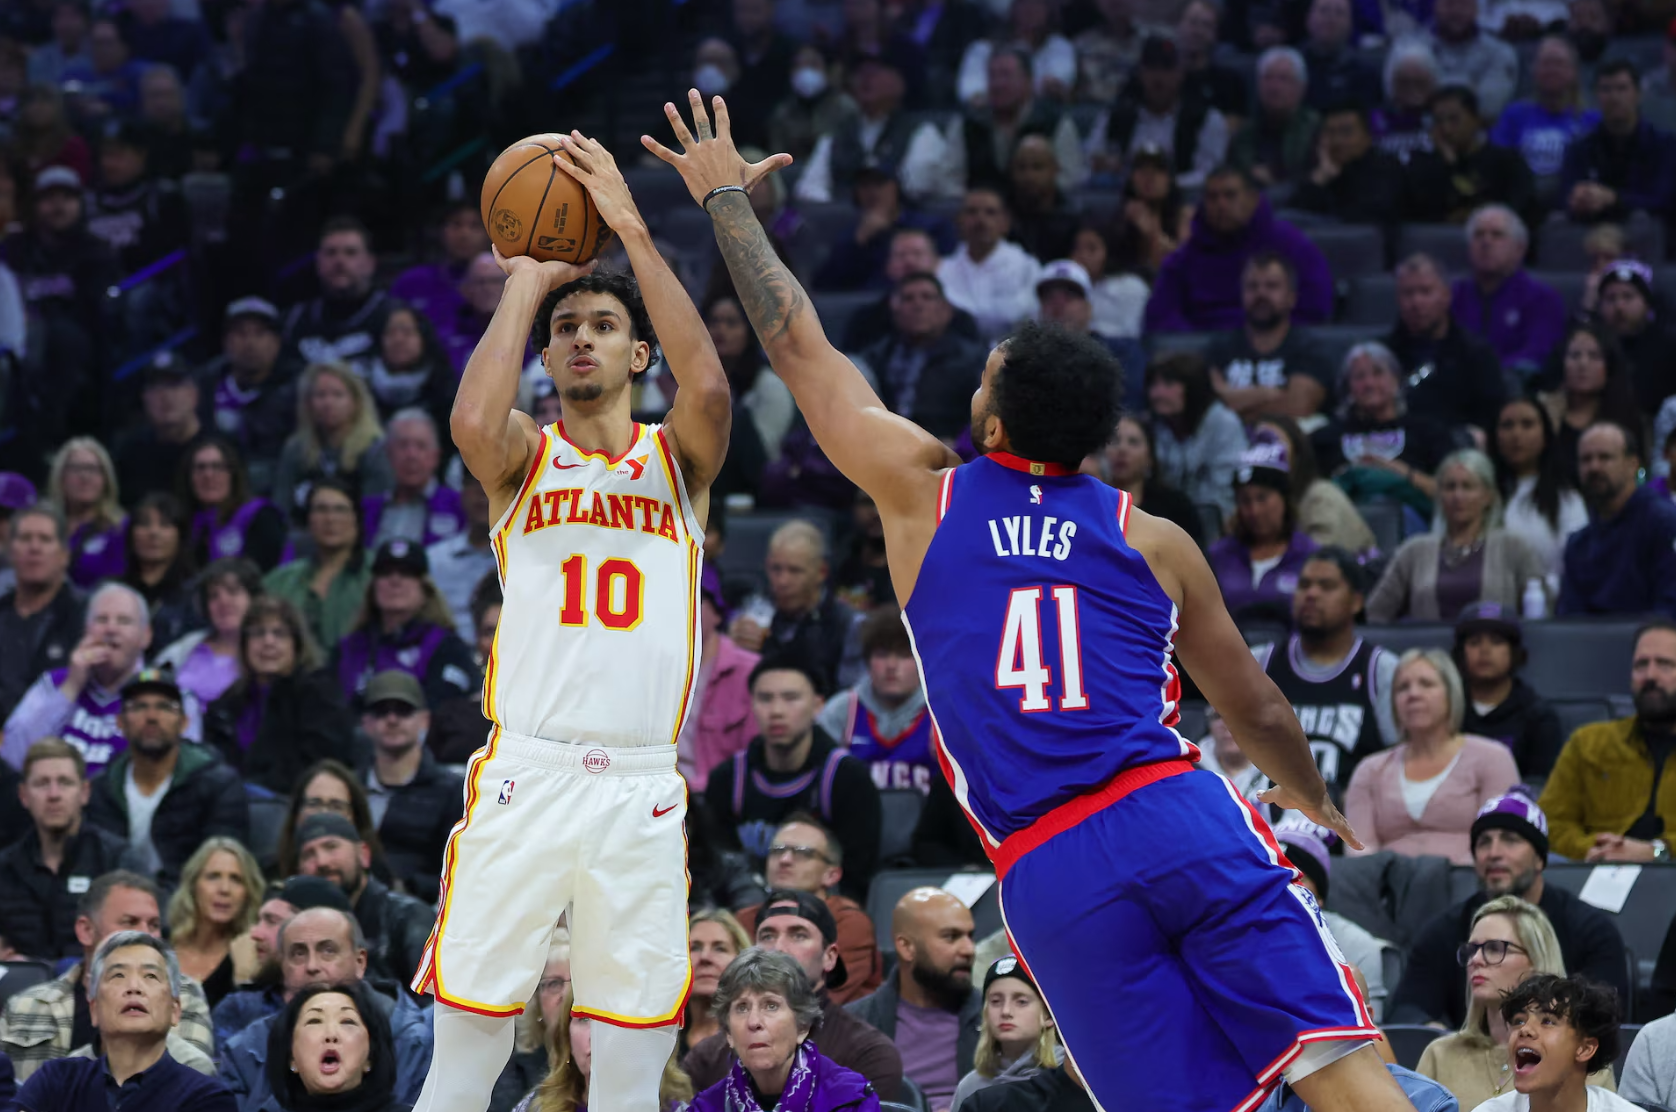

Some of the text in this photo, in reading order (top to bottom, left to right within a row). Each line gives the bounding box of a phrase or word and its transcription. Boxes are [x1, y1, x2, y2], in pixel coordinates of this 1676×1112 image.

[522, 487, 680, 546] ATLANTA
[987, 515, 1077, 561] LYLES
[559, 553, 646, 632] 10
[994, 585, 1090, 713] 41
[1293, 704, 1365, 753] NGS
[582, 756, 611, 767] HAWKS
